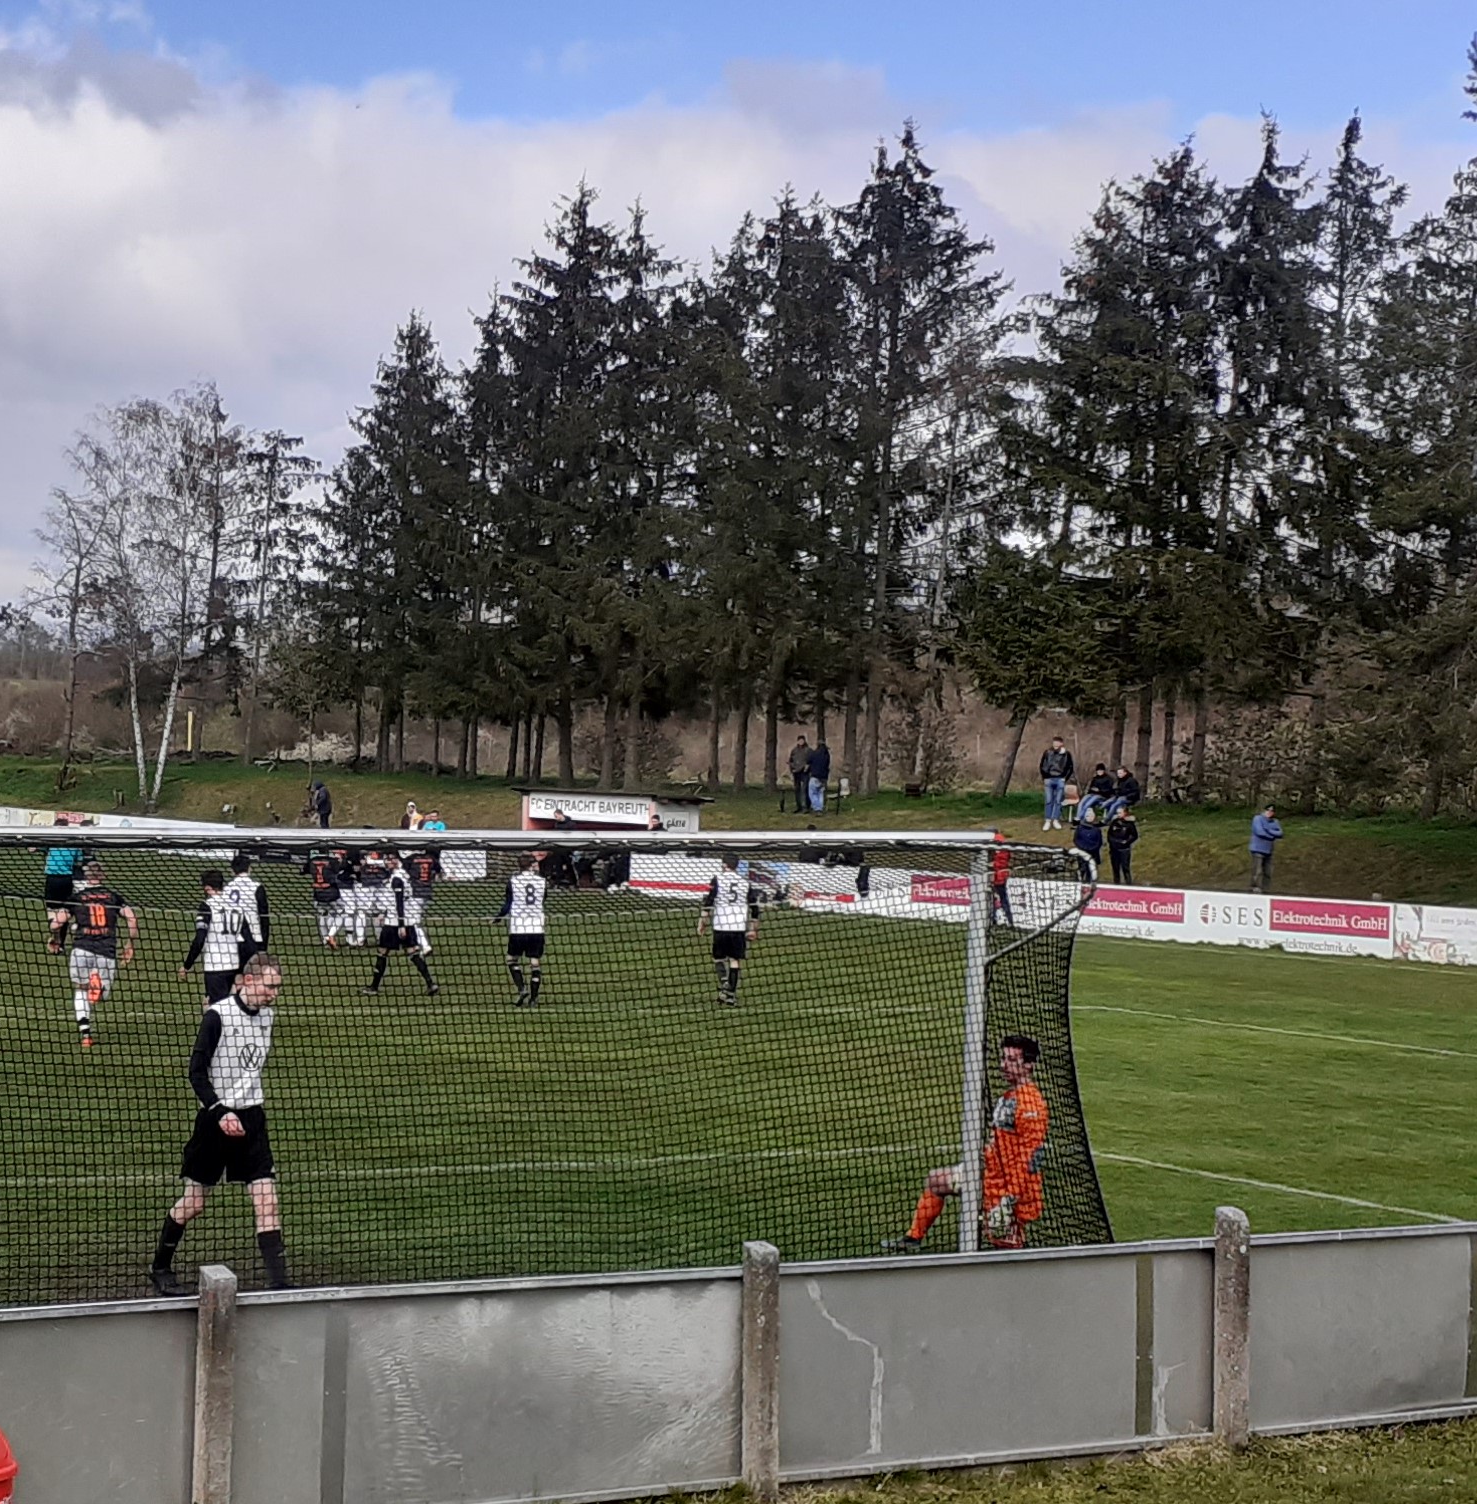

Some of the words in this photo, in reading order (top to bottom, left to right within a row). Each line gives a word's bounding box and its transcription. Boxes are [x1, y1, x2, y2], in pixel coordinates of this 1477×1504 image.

[531, 797, 543, 809] FC
[544, 798, 597, 812] EINTRACHT
[599, 801, 650, 815] BAYREUTH
[229, 889, 241, 904] 9
[525, 883, 536, 905] 8
[728, 882, 738, 903] 5
[1085, 898, 1148, 914] lektrotechnik
[1150, 901, 1183, 916] GmbH
[1222, 905, 1264, 927] SES
[219, 908, 242, 935] 10
[1272, 910, 1348, 928] Elektrotechnik
[1350, 914, 1388, 931] GmbH
